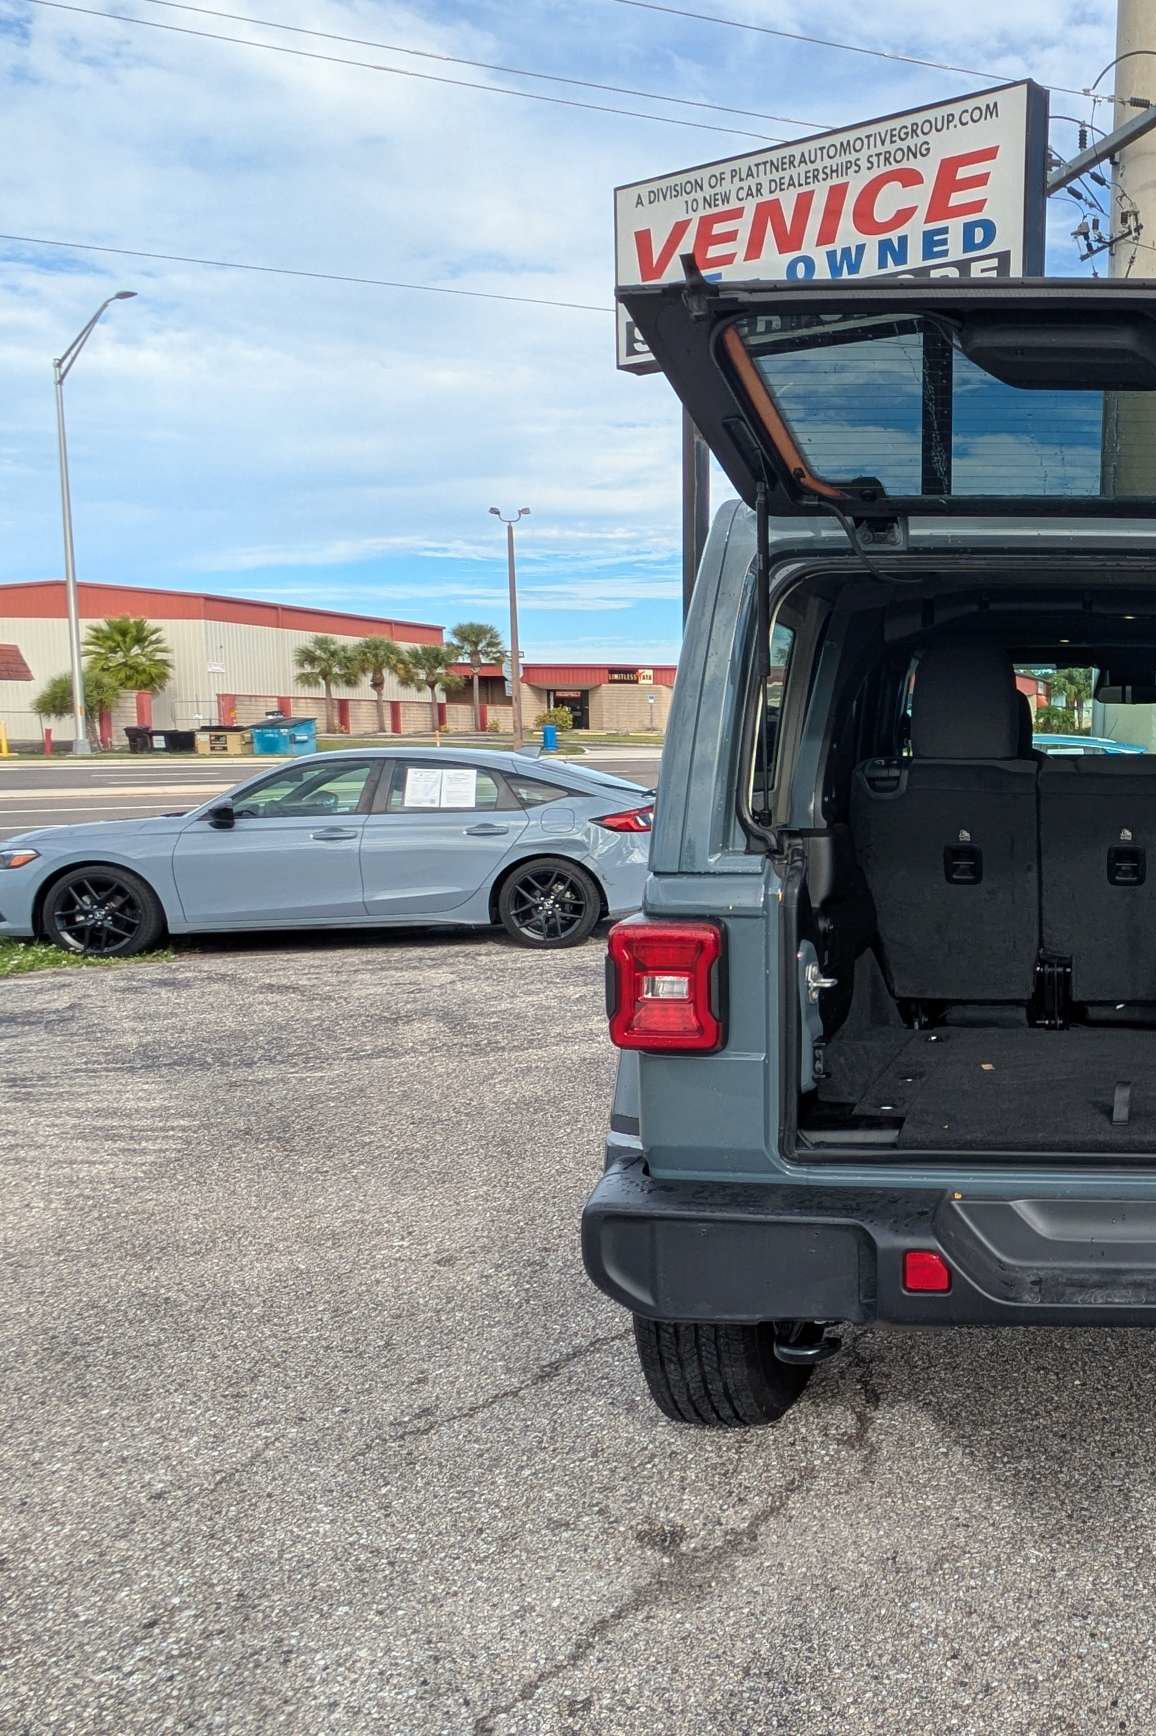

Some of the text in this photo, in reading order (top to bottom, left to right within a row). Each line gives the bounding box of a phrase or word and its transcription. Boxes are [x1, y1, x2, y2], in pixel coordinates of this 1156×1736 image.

[635, 101, 999, 208] A DIVISION OF PLATTNERAUTOMOTIVEGROUP.COM
[684, 141, 931, 214] 10 NEW CAR DEALERSHIPS STRONG
[634, 145, 1000, 282] VENICE
[786, 218, 997, 280] OWNED
